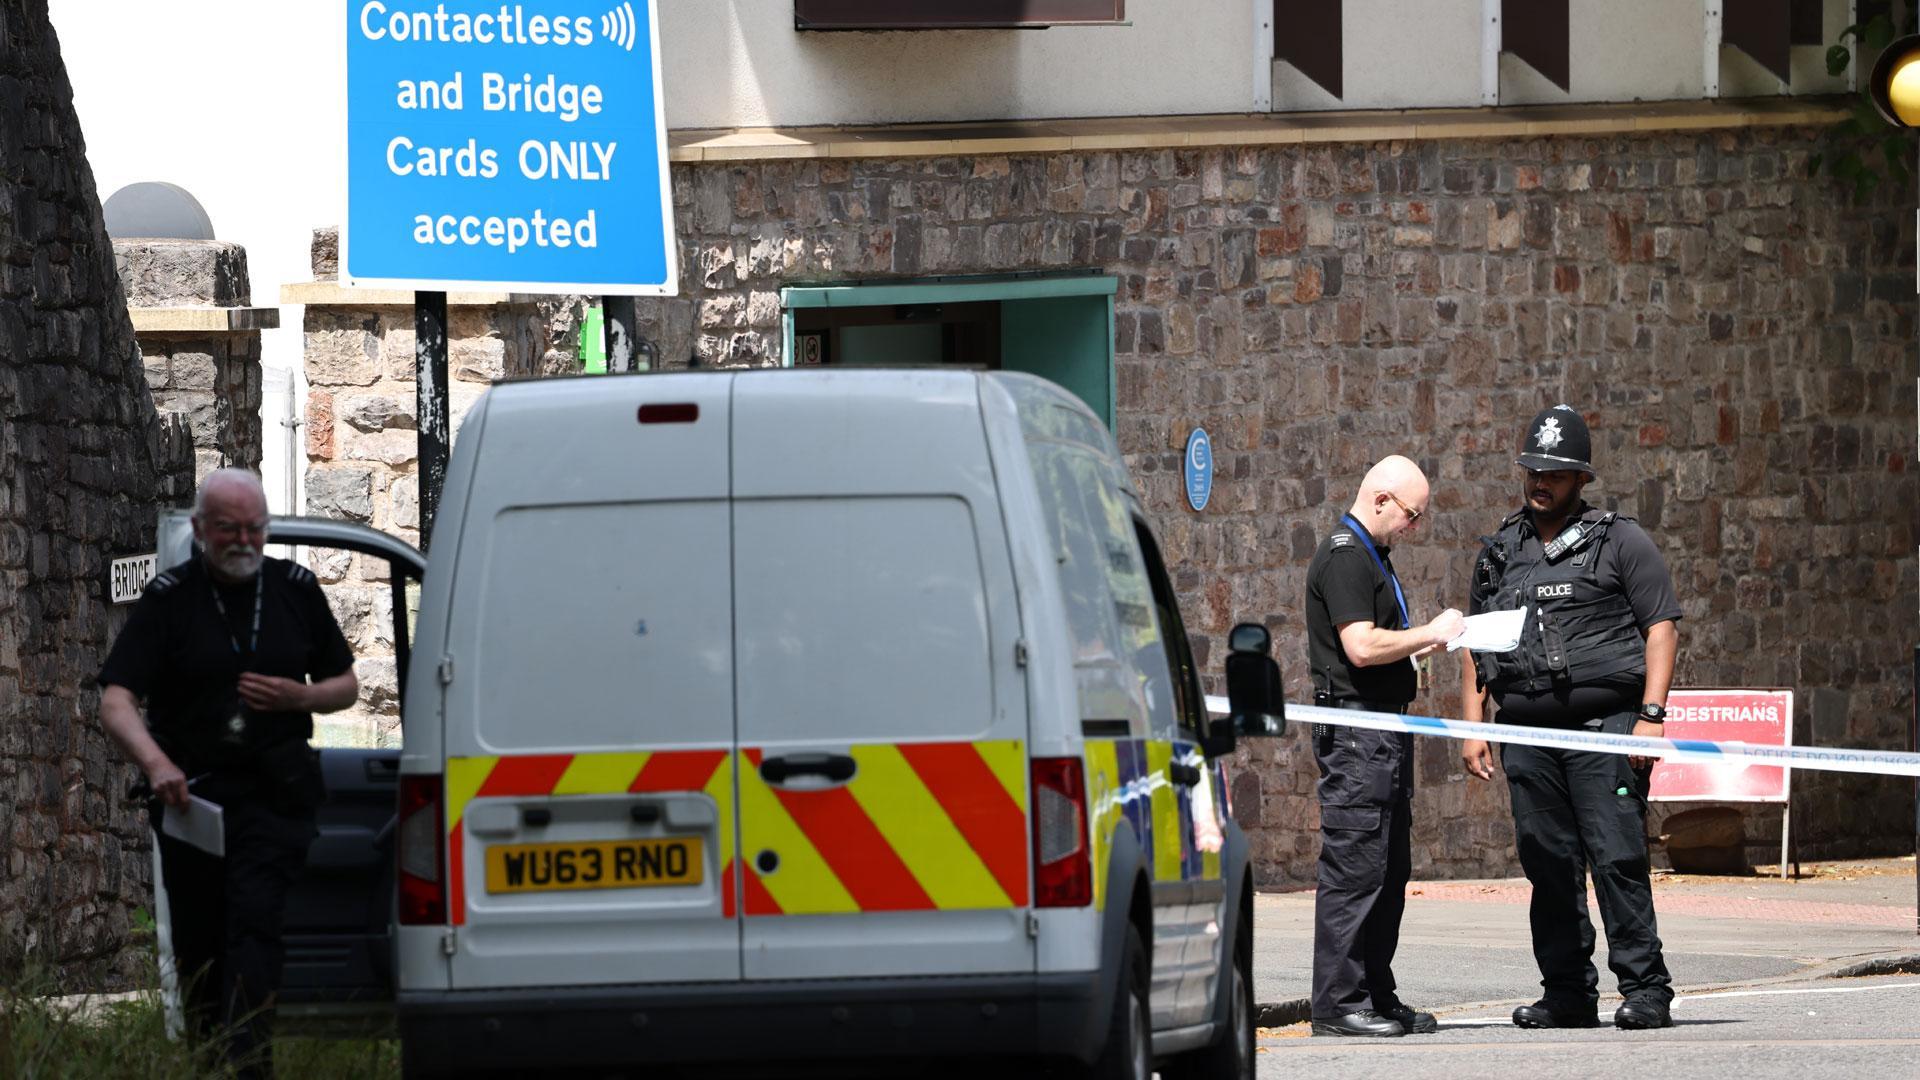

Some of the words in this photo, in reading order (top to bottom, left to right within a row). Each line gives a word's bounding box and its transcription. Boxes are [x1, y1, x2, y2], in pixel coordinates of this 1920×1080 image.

[360, 1, 593, 46] Contactless
[397, 71, 463, 110] and
[482, 72, 603, 122] Bridge
[386, 136, 499, 178] Cards
[518, 140, 617, 181] ONLY
[413, 208, 598, 253] accepted
[114, 559, 150, 598] BRIDGE
[1537, 583, 1572, 597] POLICE
[1663, 705, 1779, 722] EDESTRIANS
[504, 847, 603, 886] WU63
[614, 843, 688, 880] RNO
